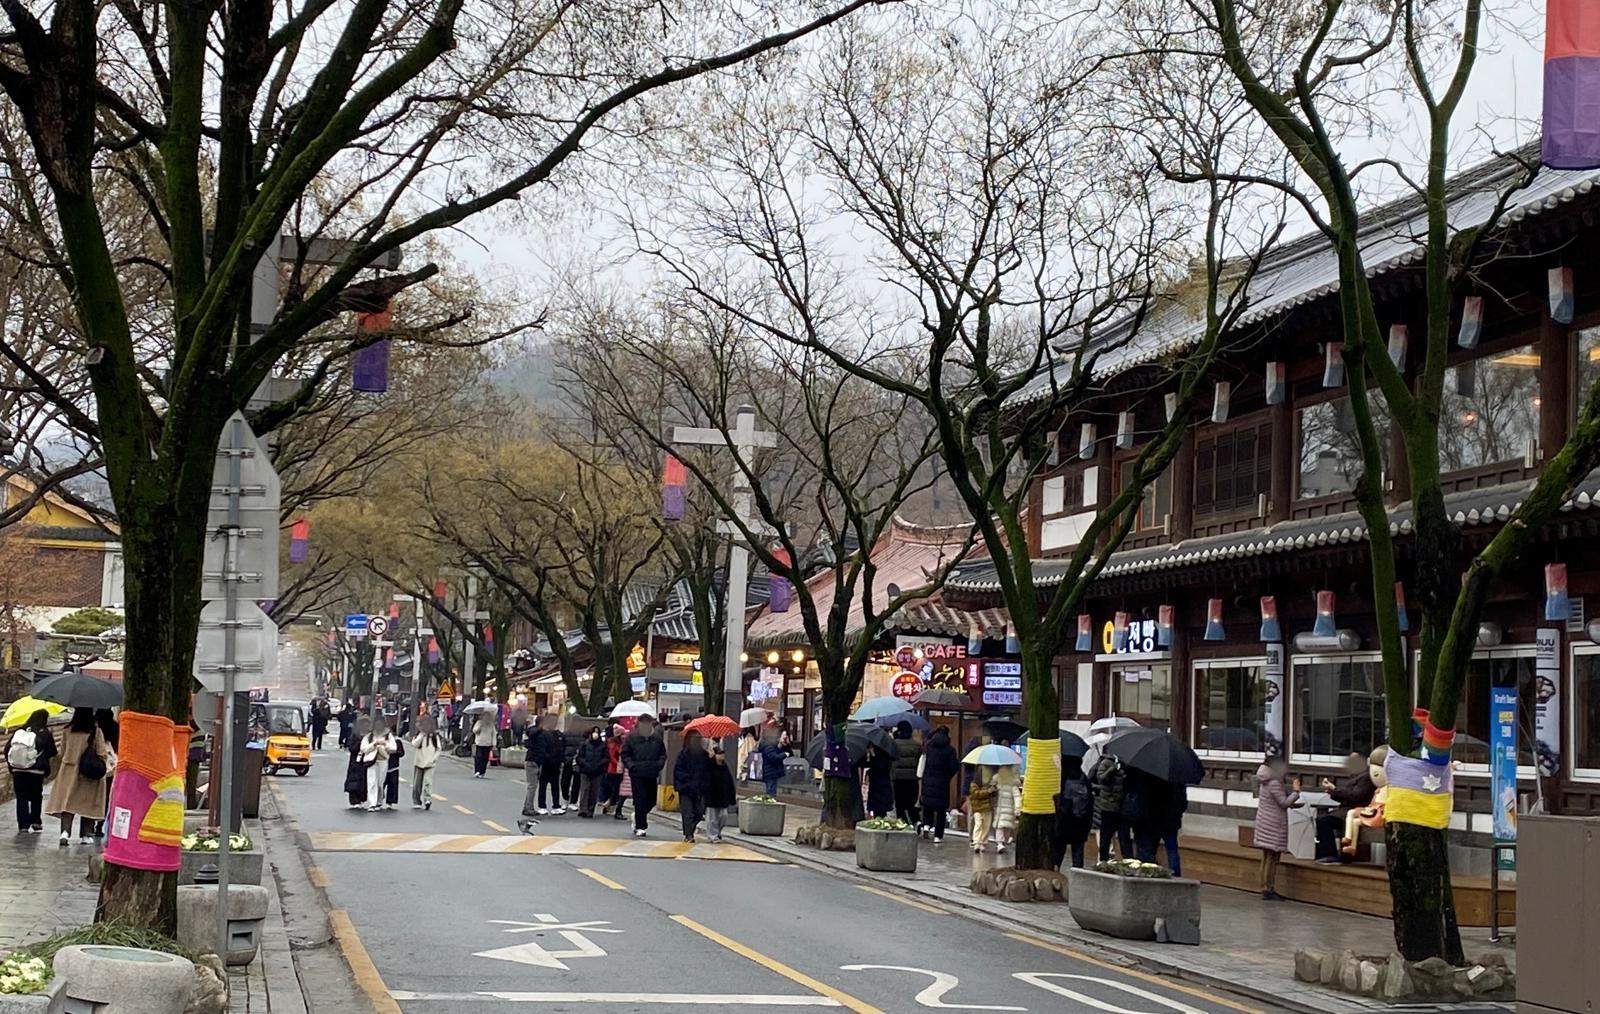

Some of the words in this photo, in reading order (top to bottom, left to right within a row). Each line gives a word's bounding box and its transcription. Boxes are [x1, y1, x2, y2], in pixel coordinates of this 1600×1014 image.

[1115, 619, 1155, 653] 전빵
[924, 645, 966, 659] CAFE
[934, 664, 965, 681] 누이
